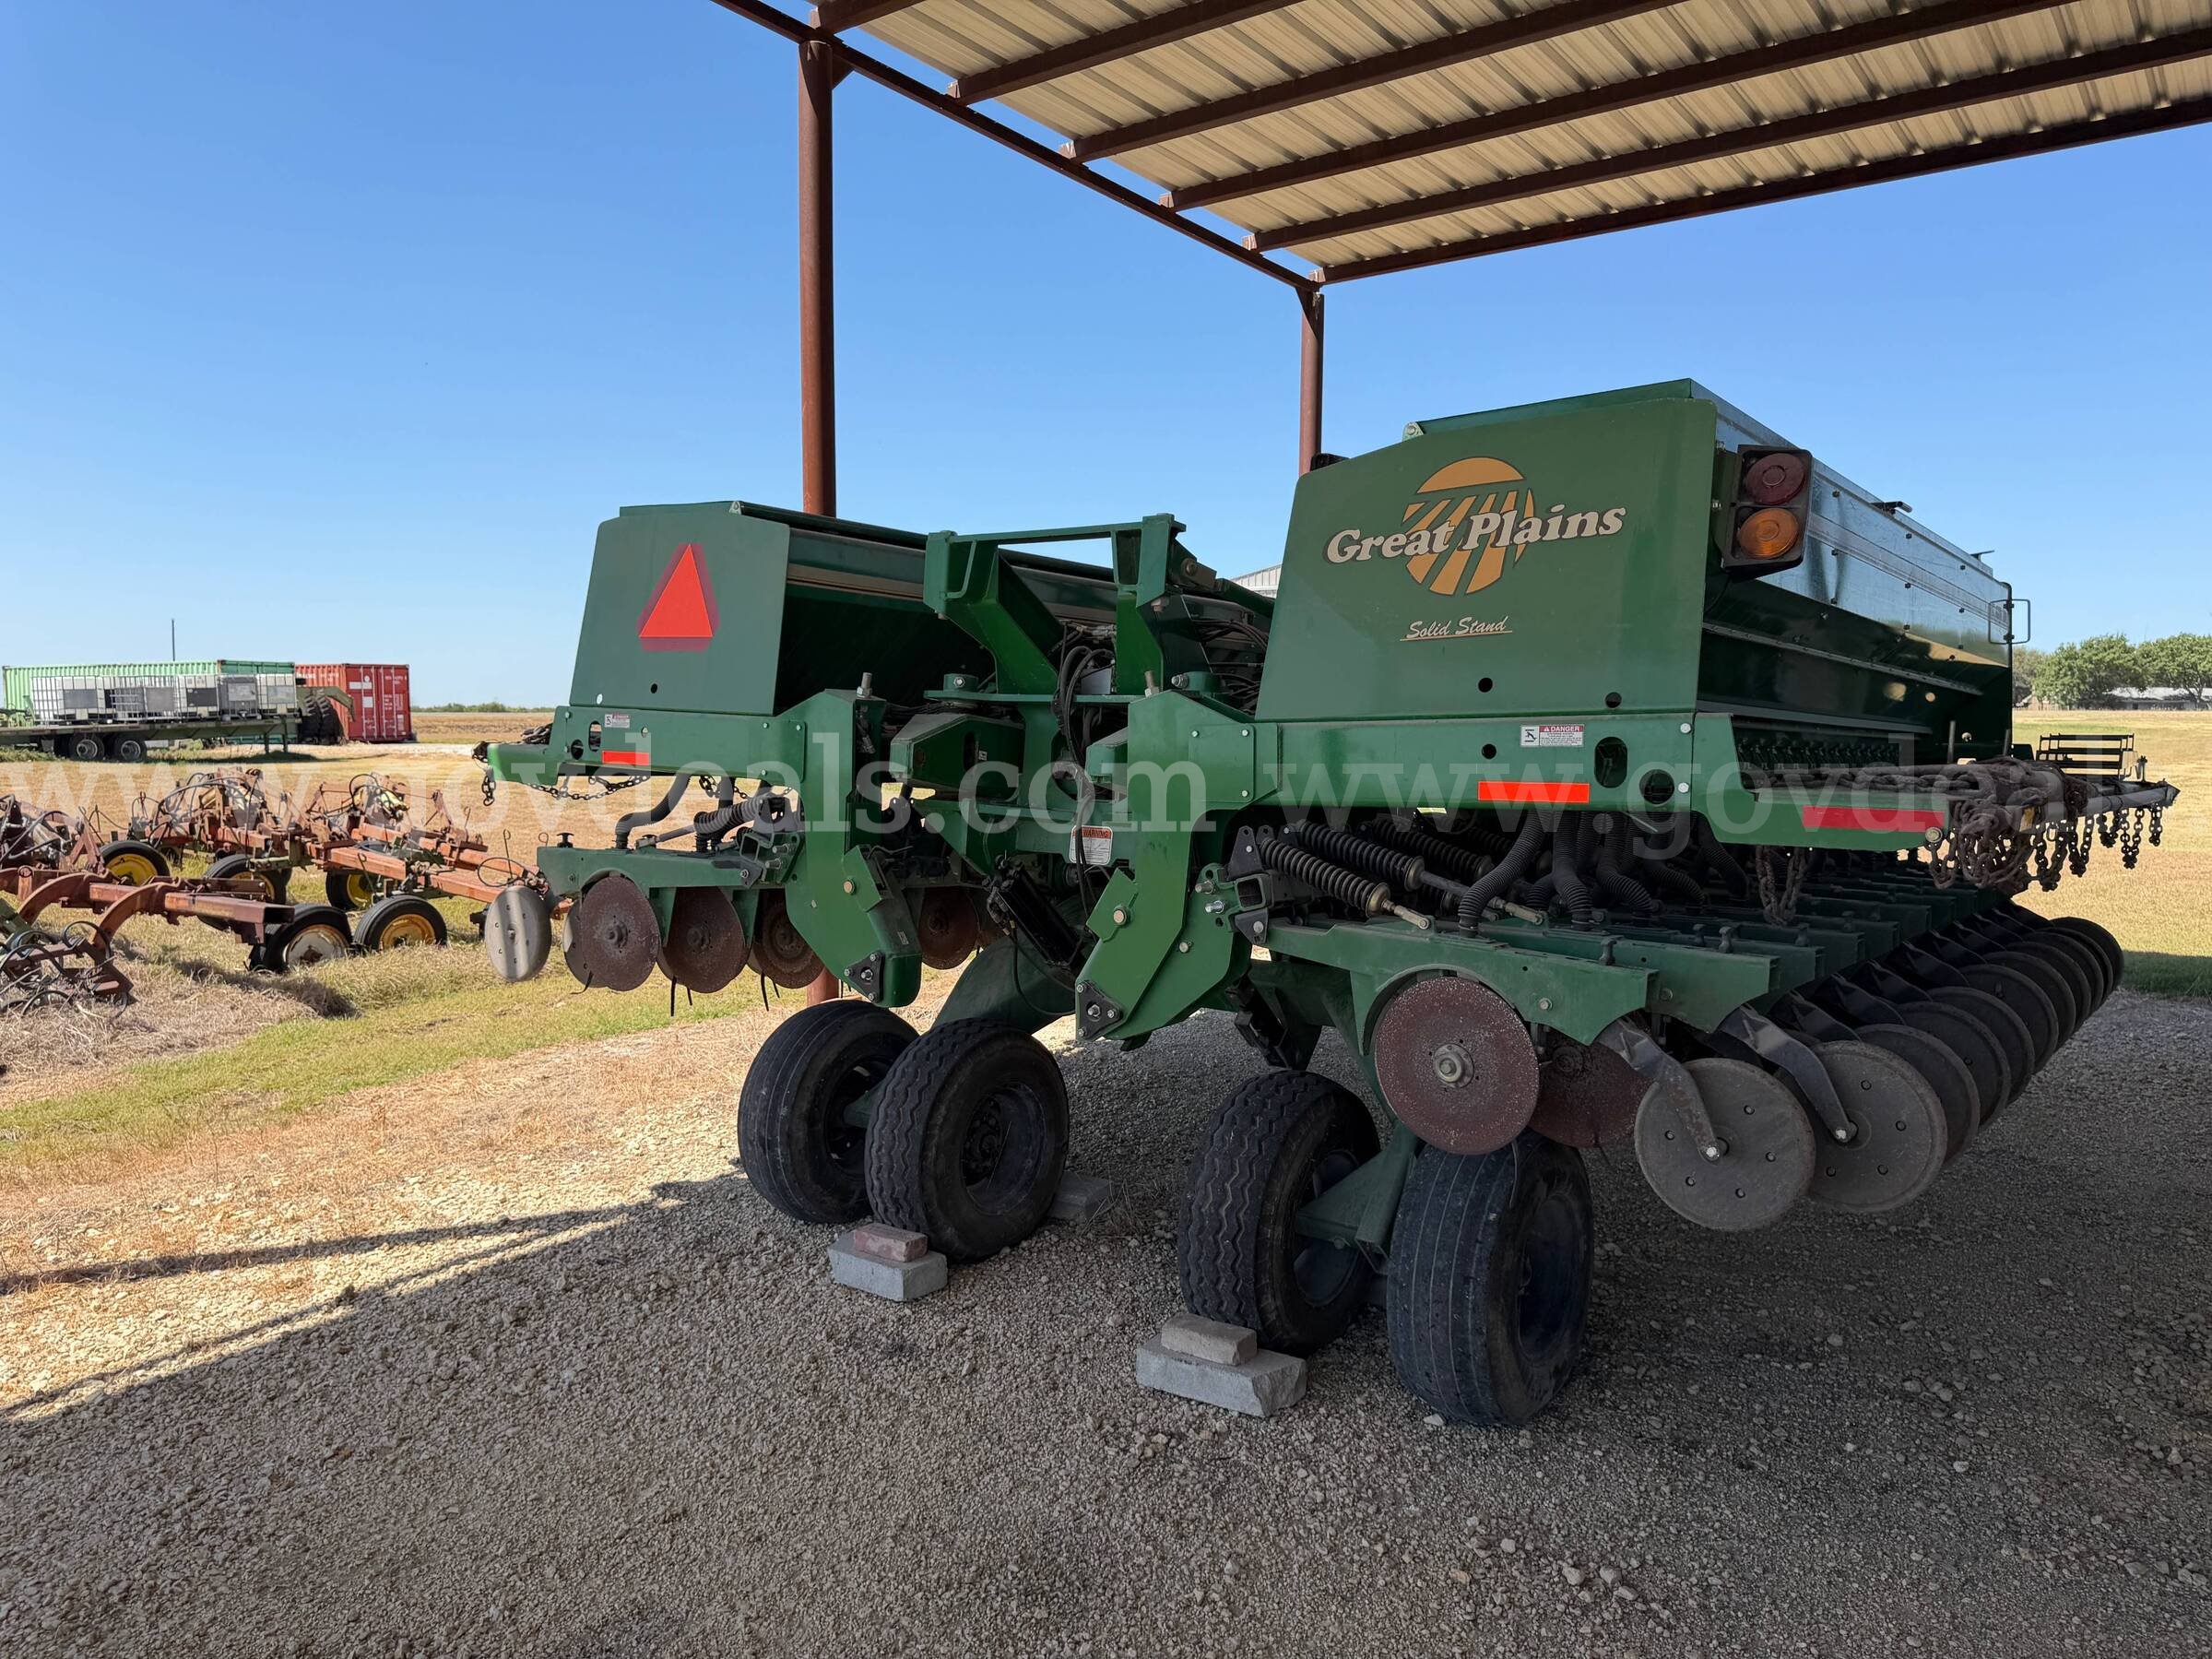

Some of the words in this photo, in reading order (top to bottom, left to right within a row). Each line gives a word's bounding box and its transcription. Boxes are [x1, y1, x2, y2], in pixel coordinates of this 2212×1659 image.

[1326, 519, 1456, 564] Great
[1457, 504, 1626, 551] Plains
[1405, 621, 1451, 639] Solid
[1455, 615, 1508, 636] Stand
